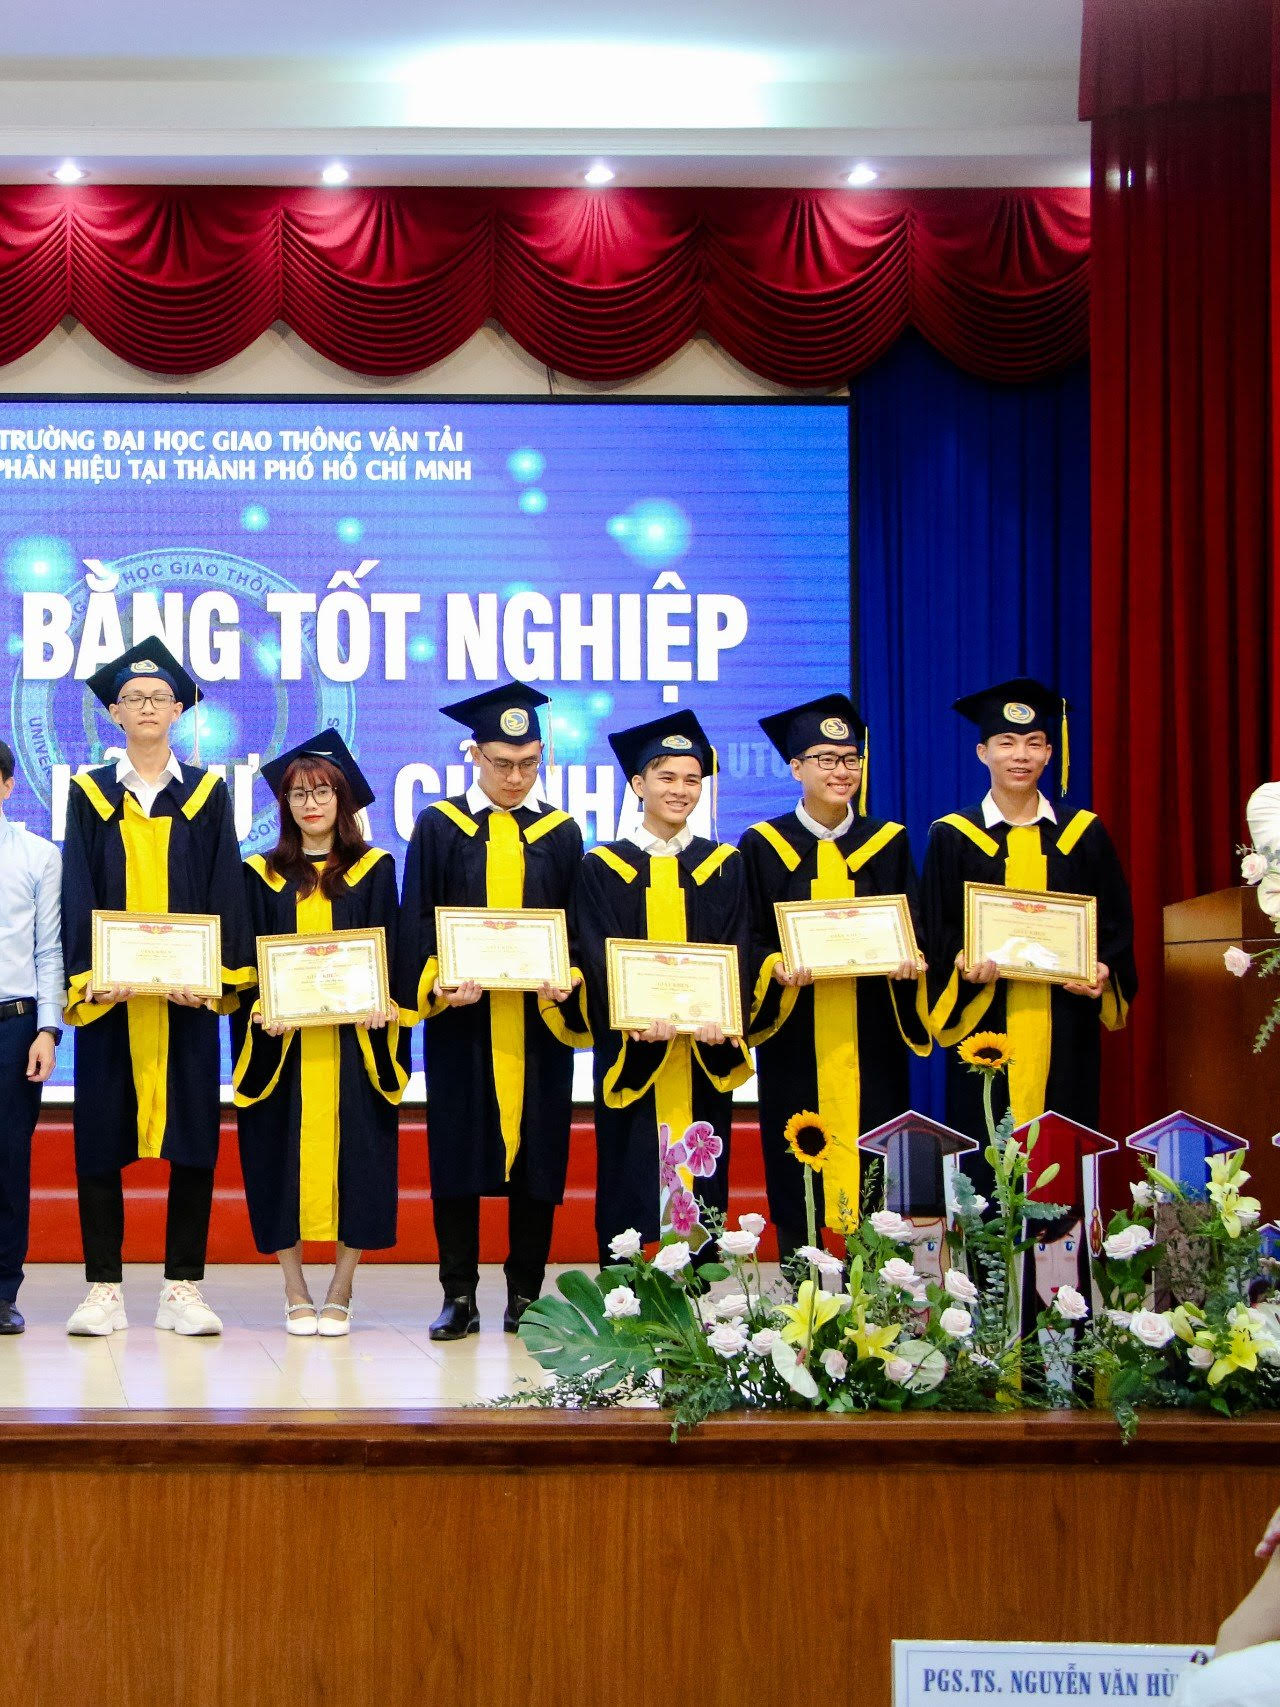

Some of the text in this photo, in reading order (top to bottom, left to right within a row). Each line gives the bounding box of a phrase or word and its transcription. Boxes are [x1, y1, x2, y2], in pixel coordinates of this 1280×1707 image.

[103, 430, 145, 456] ĐẠI
[154, 430, 206, 456] HỌC
[212, 430, 273, 452] GIAO
[278, 425, 362, 452] THÔNG
[368, 425, 419, 457] VẬN
[424, 424, 463, 452] TẢI
[64, 453, 121, 485] HIỆU
[127, 458, 167, 485] TẠI
[173, 453, 256, 481] THÀNH
[264, 450, 315, 481] PHỐ
[322, 450, 358, 481] HỒ
[365, 453, 407, 481] CHÍ
[122, 561, 277, 596] HỌC GIAO THÔN
[22, 558, 241, 681] BẰNG
[265, 560, 421, 682] TỐT
[446, 571, 748, 703] NGHIỆP
[923, 1663, 1179, 1697] PGS.TS. NGUYỄN VĂN HÙ
